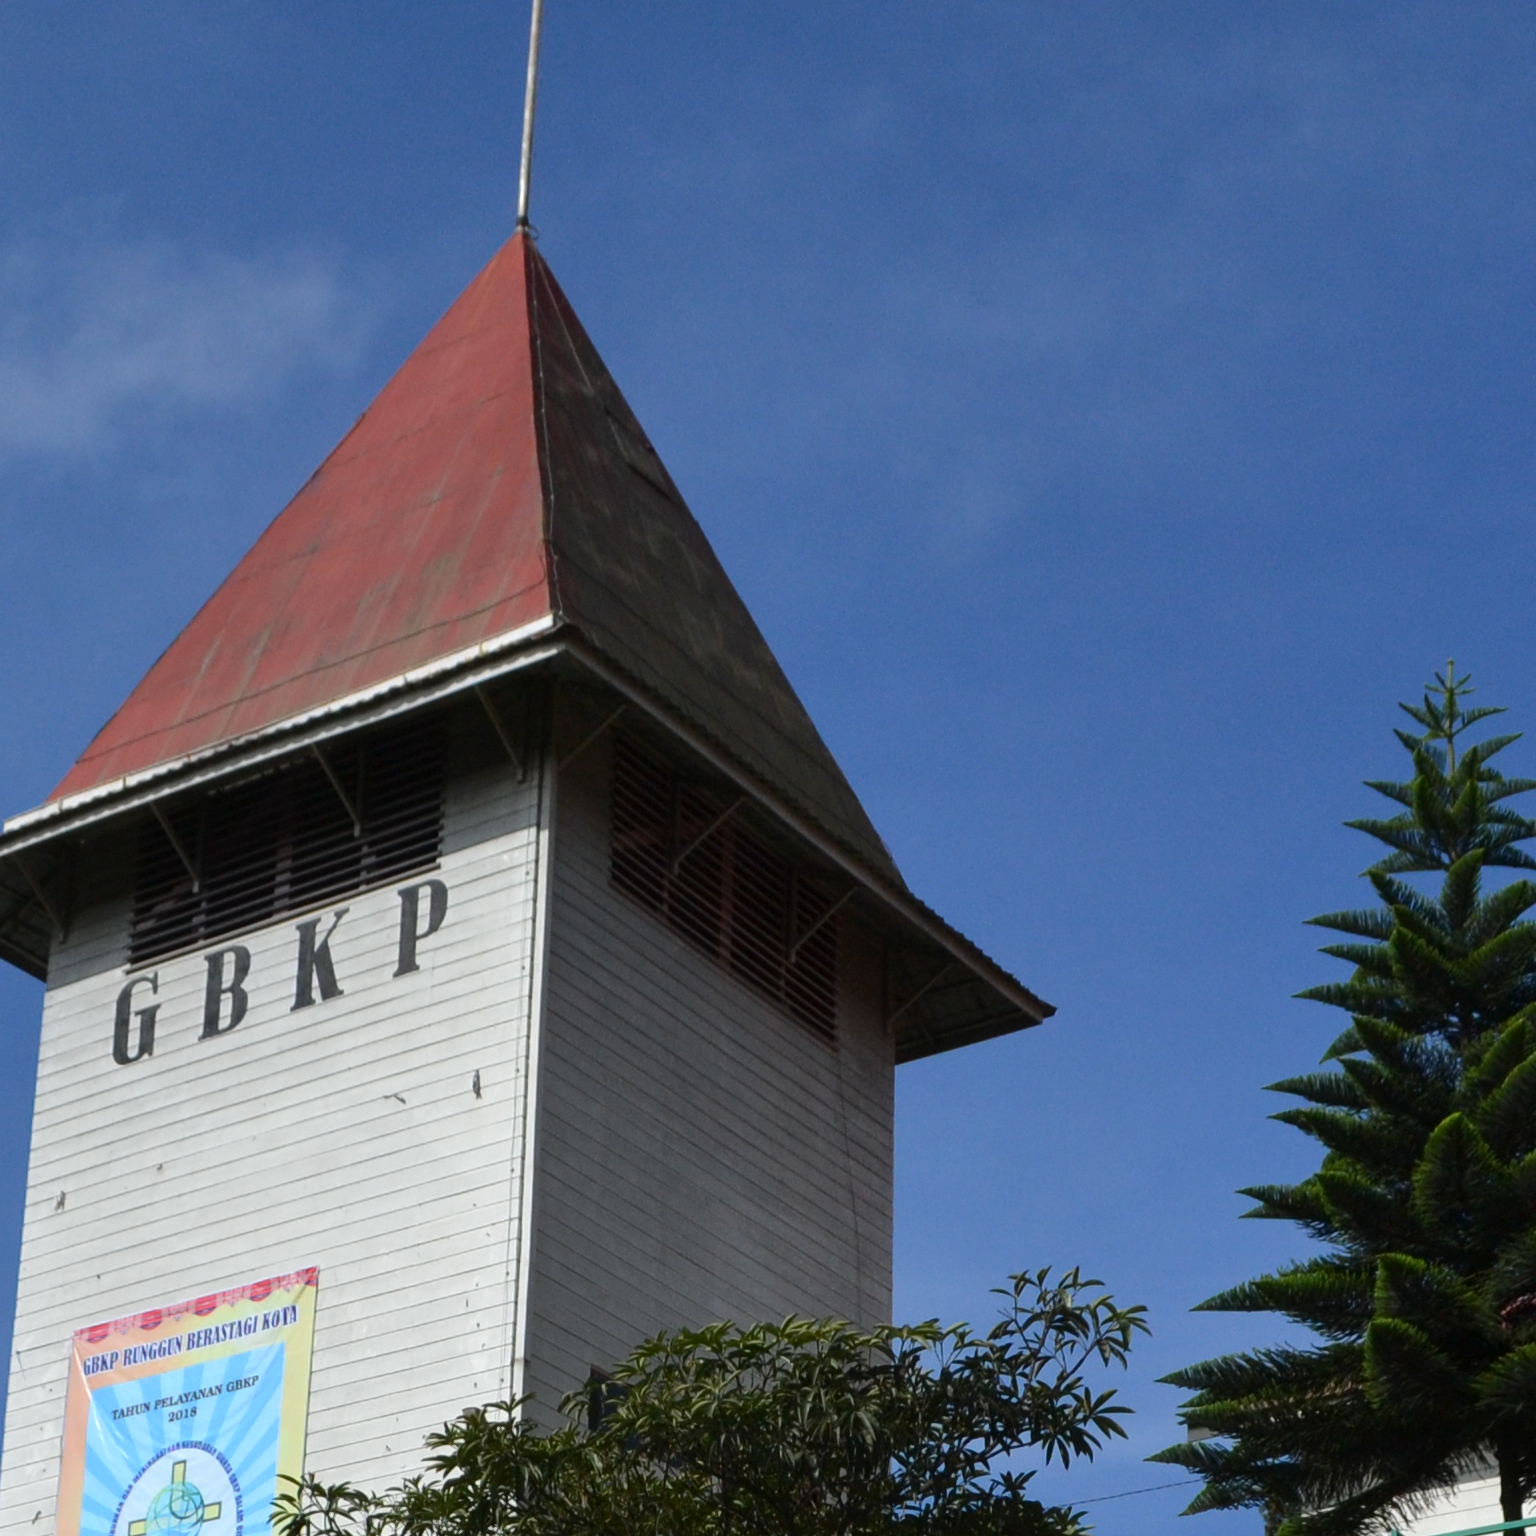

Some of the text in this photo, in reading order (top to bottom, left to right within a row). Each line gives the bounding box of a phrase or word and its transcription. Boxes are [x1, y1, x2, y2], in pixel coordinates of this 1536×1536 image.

[112, 879, 448, 1065] GBKP
[83, 1305, 297, 1376] GBKP RUNGGUN BERASTAGI KOTA
[111, 1375, 259, 1420] TAHUN PELAYANAN GBKP
[168, 1406, 197, 1423] 2018
